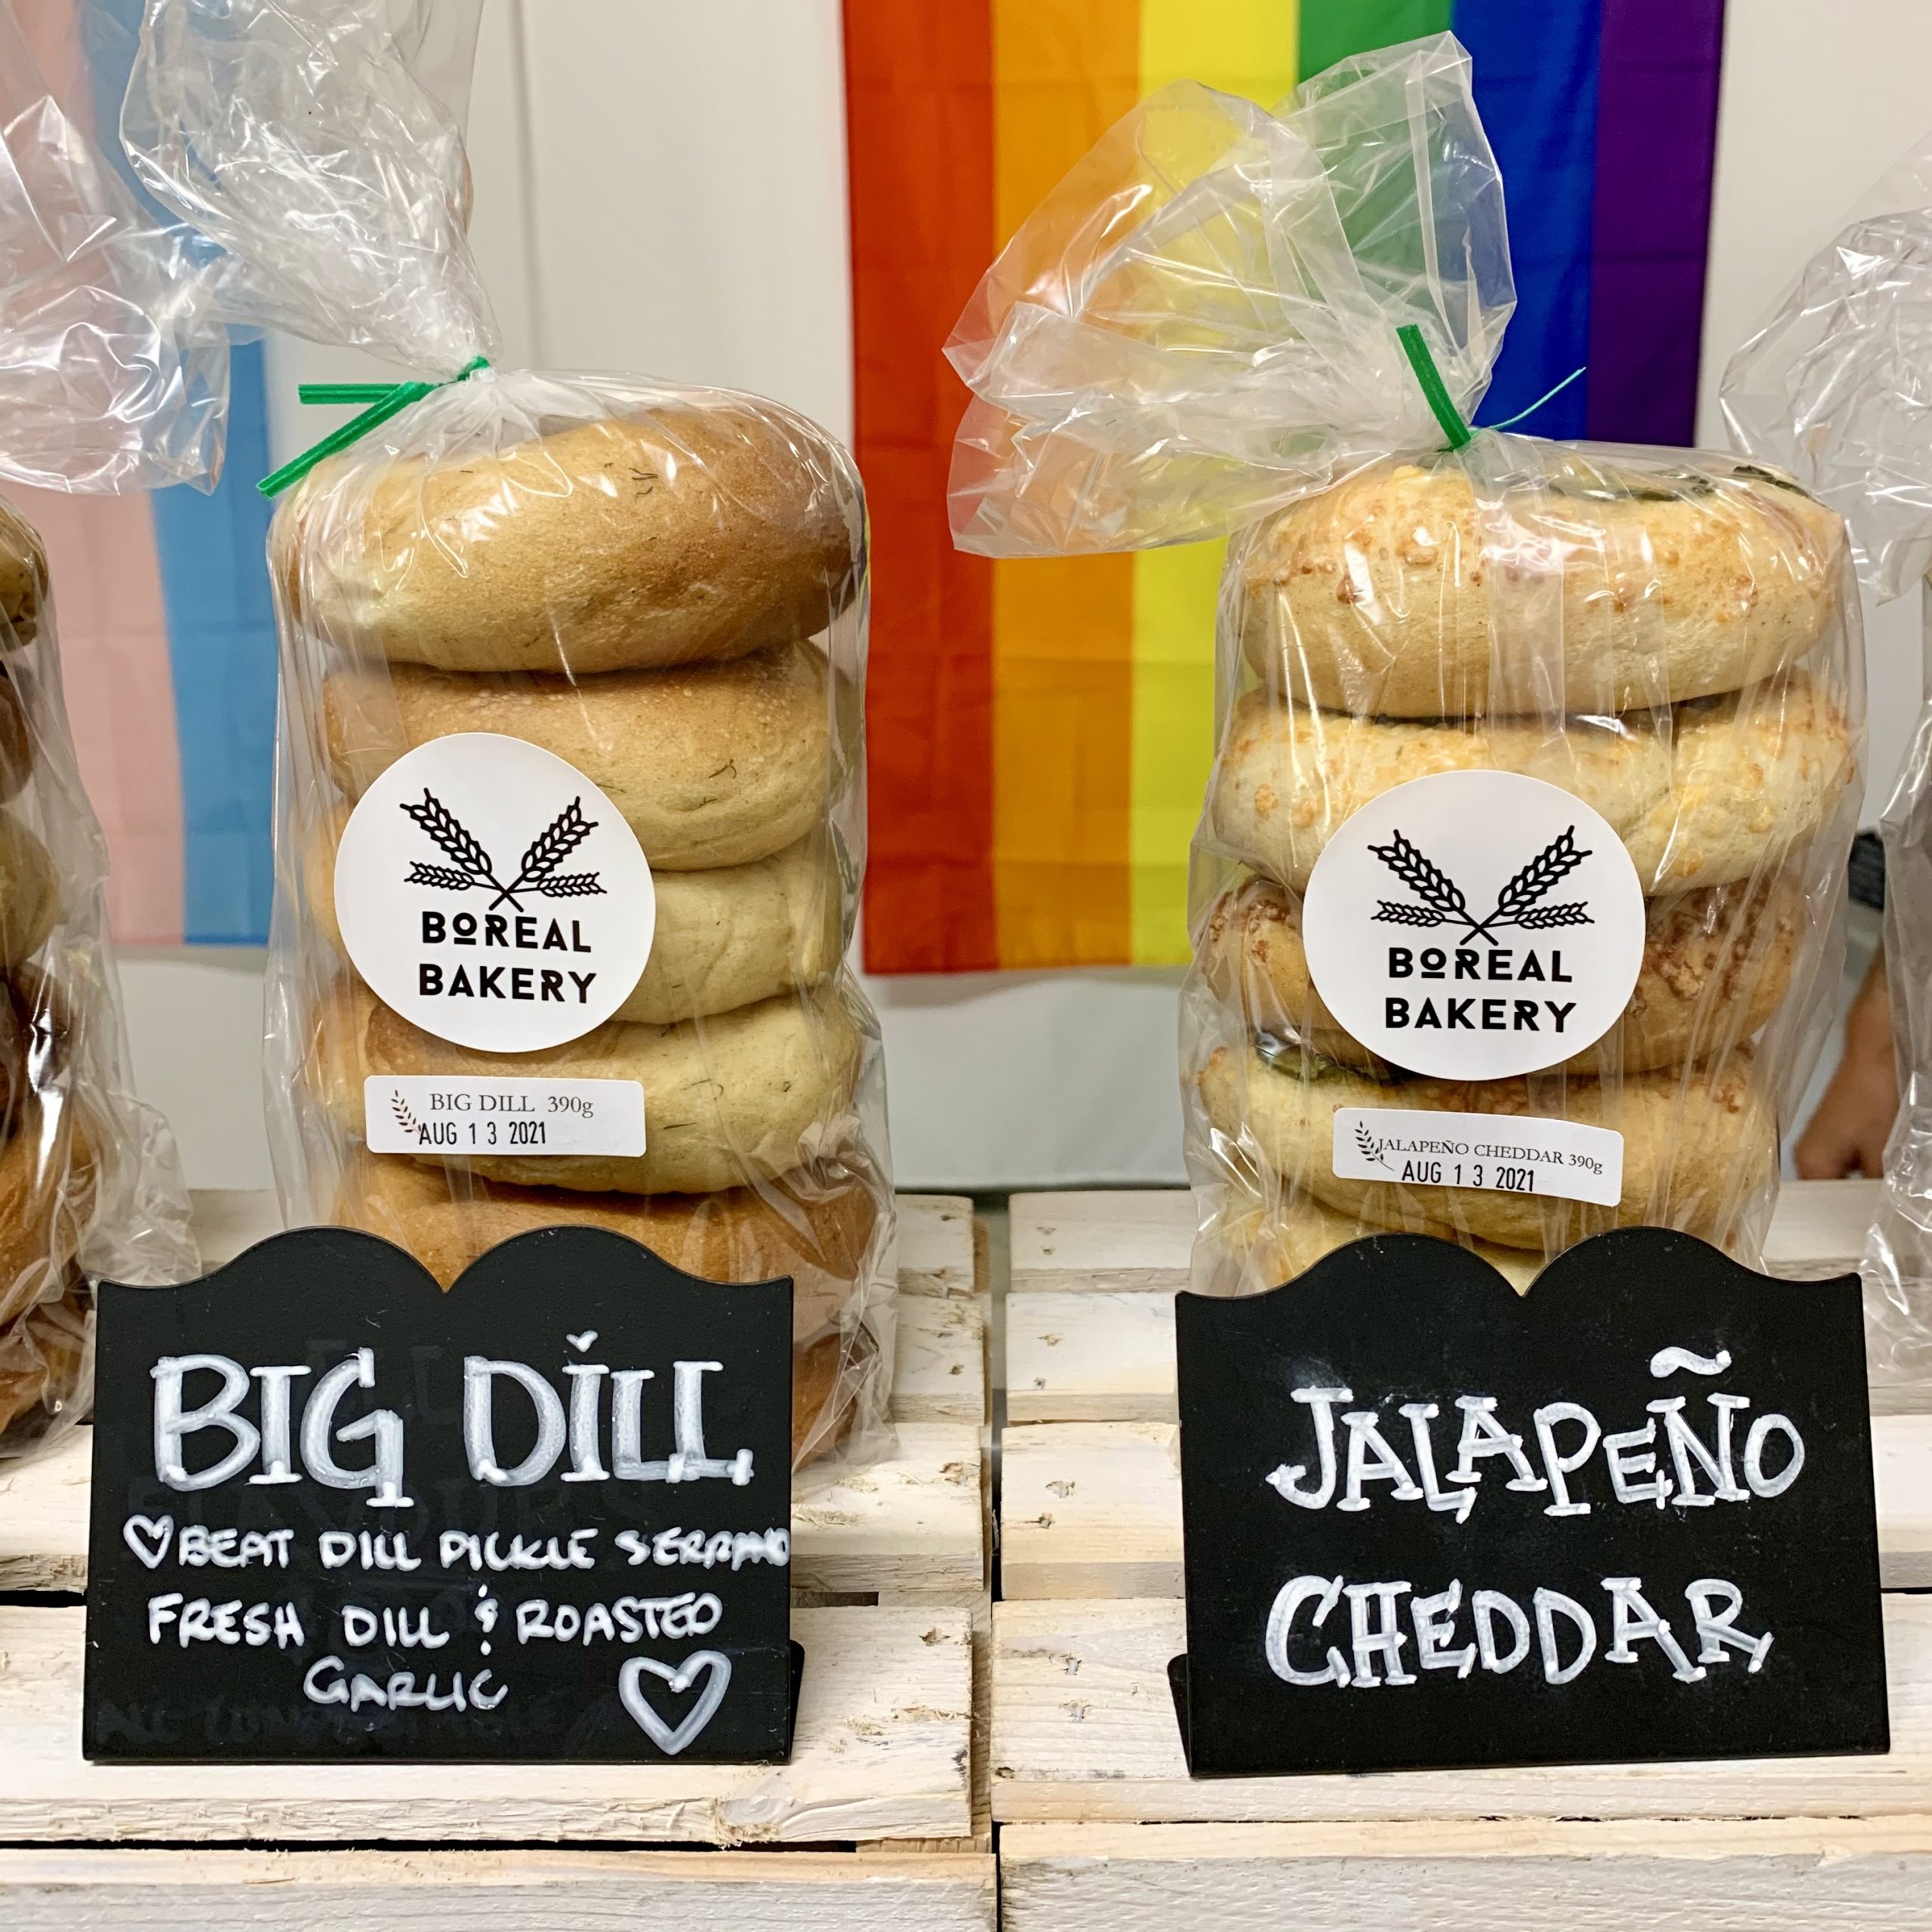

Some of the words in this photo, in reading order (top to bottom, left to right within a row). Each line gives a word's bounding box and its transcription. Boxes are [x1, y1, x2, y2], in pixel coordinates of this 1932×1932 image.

[423, 910, 592, 953] BOREAL
[419, 963, 597, 1004] BAKERY
[1389, 946, 1573, 983] BOREAL
[1385, 997, 1577, 1033] BAKERY
[430, 1094, 472, 1111] BIG
[479, 1094, 536, 1112] DILL
[548, 1097, 594, 1118] 390g
[419, 1121, 457, 1146] AUG
[509, 1121, 546, 1145] 2021
[1377, 1138, 1469, 1155] JALAPEÑO
[1474, 1144, 1564, 1164] CHEDDAR
[1568, 1154, 1604, 1175] 390g
[1401, 1160, 1441, 1183] AUG
[1496, 1166, 1535, 1192] 2021
[150, 1347, 414, 1507] BIG
[1266, 1346, 1805, 1524] JALAPEÑO
[178, 1525, 294, 1568] BEAT
[318, 1530, 422, 1571] DILL
[439, 1528, 598, 1571] PICKLE
[148, 1592, 305, 1649] FRESH
[342, 1605, 450, 1648] DILL
[516, 1592, 723, 1646] ROASTED
[1266, 1574, 1775, 1688] CHEDDAR
[303, 1656, 508, 1712] GARLIC
